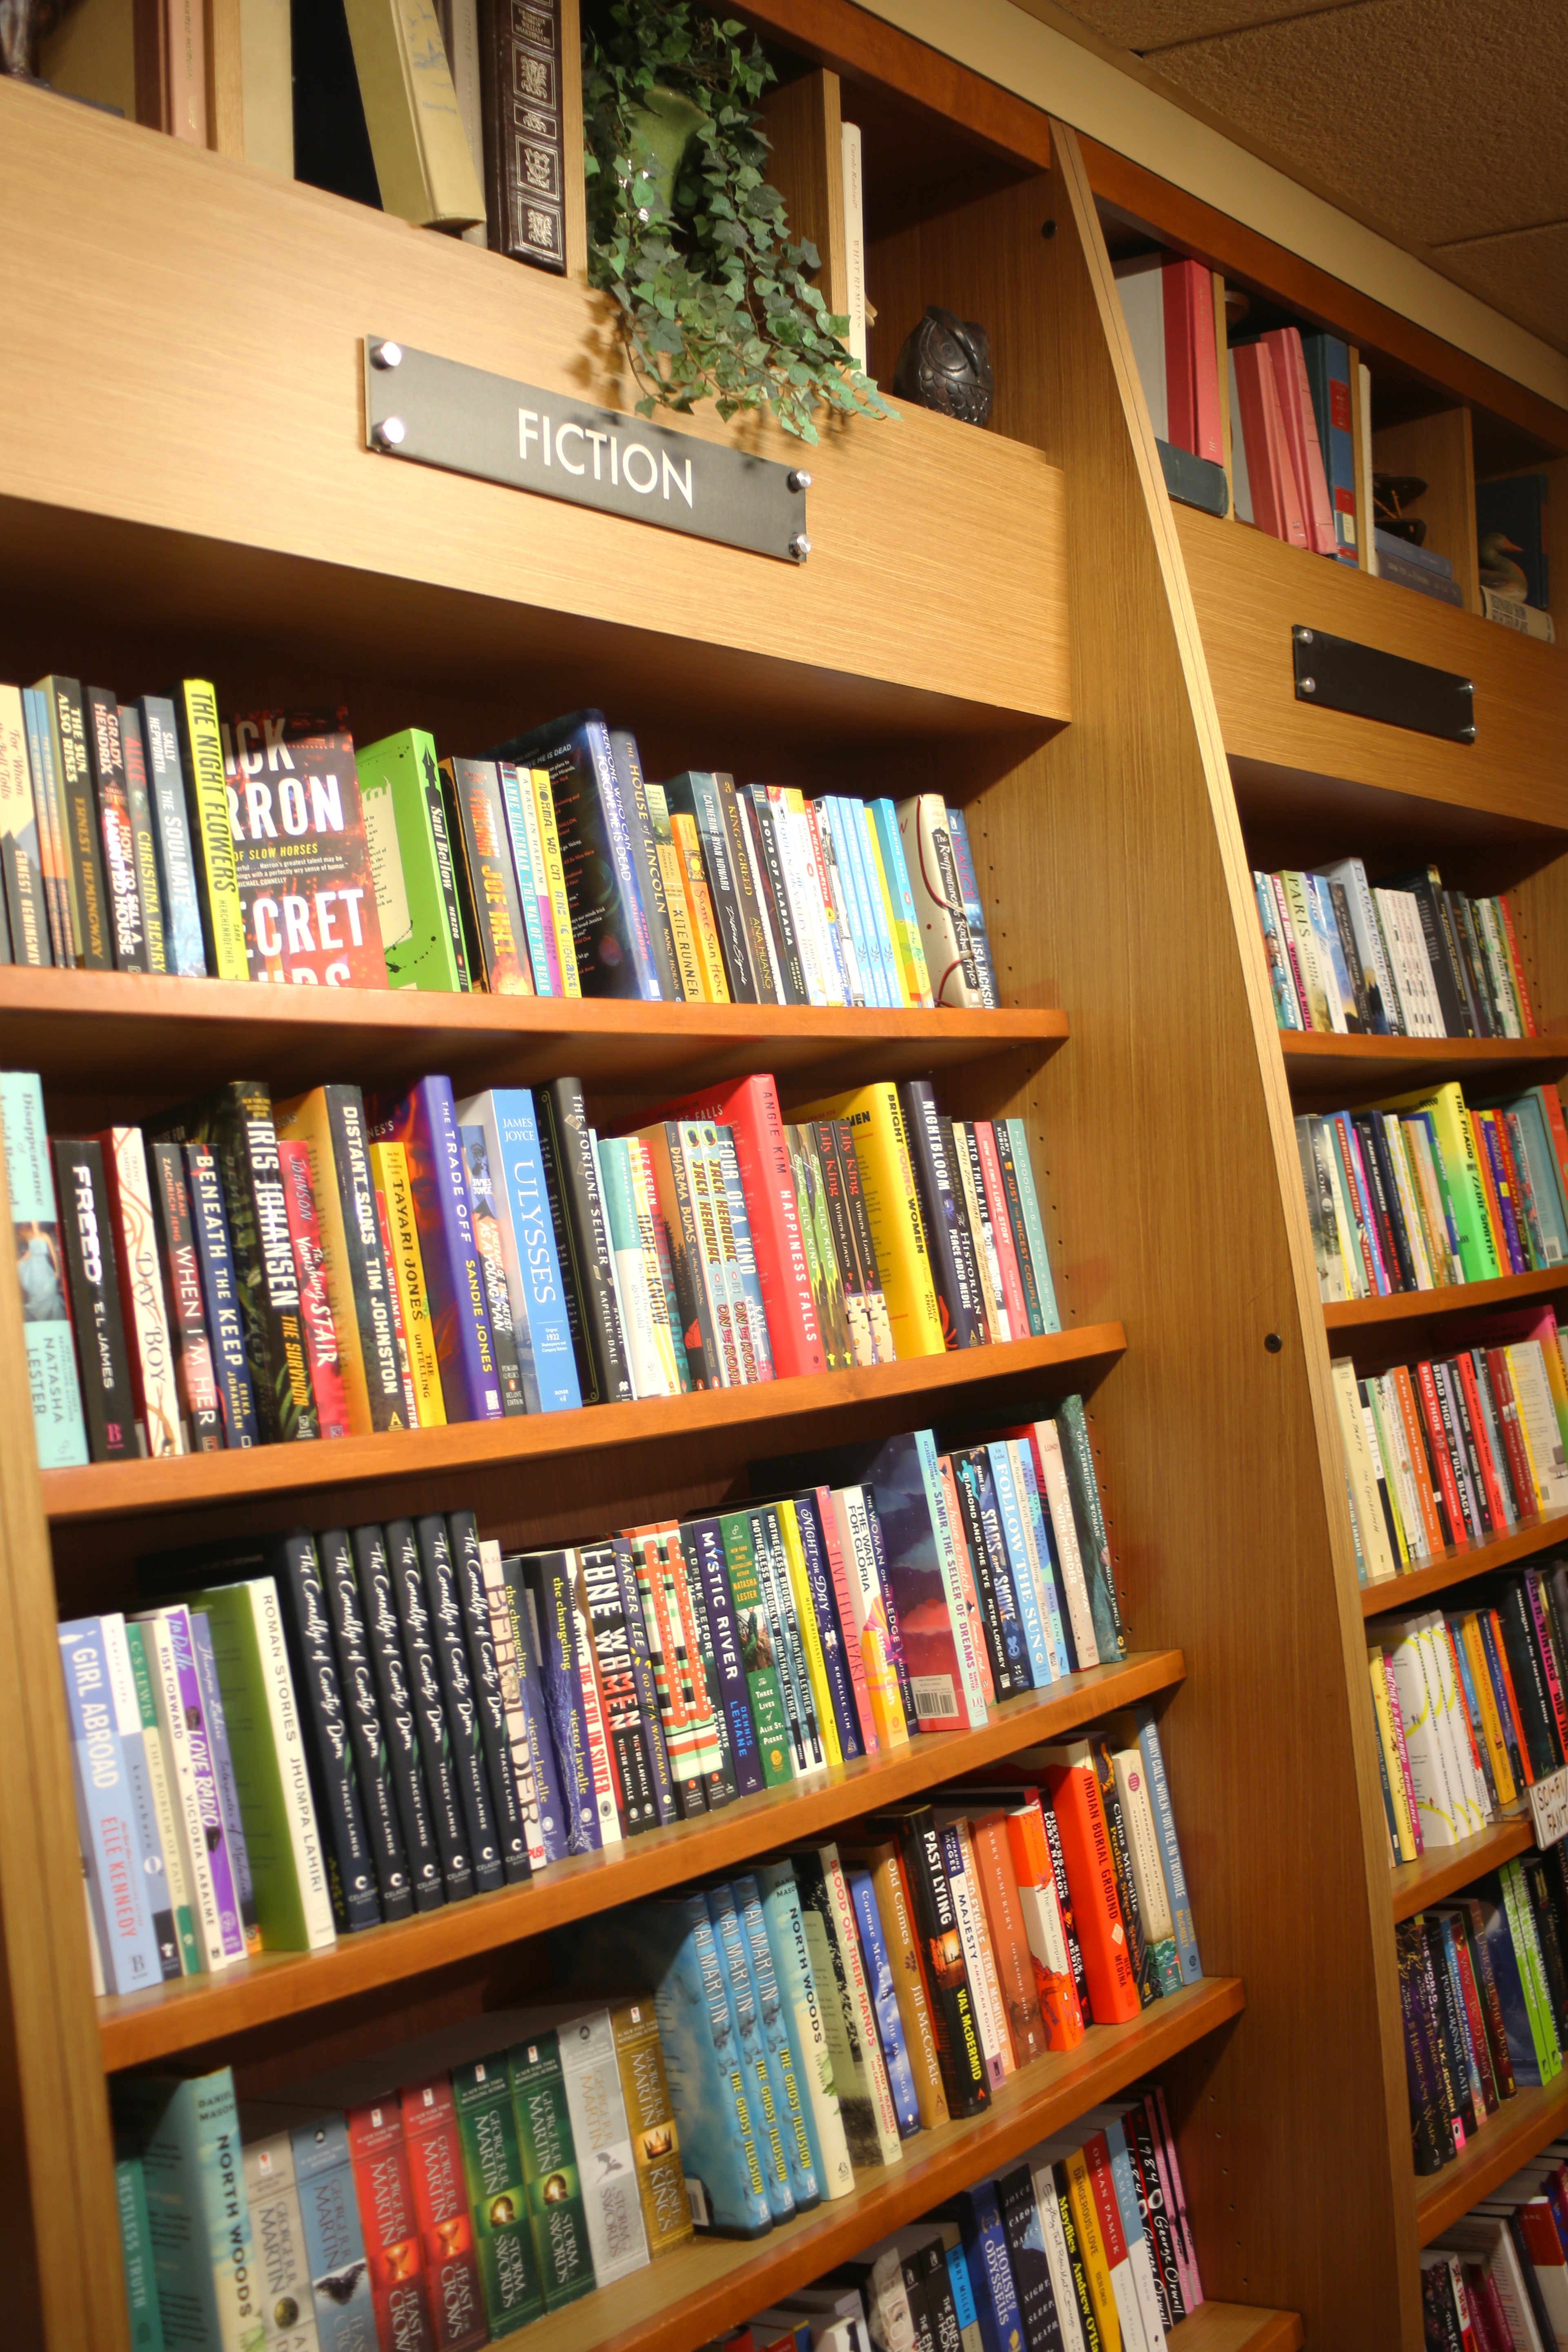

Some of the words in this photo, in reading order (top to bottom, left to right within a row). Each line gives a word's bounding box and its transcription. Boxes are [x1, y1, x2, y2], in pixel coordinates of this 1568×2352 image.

[515, 24, 550, 45] SHAKESPEARE
[521, 20, 543, 36] WILLIAM
[519, 408, 692, 508] FICTION
[58, 692, 72, 731] ALSO
[70, 707, 82, 736] THE
[191, 693, 215, 728] THE
[61, 738, 78, 783] RISES
[75, 744, 88, 773] SUN
[149, 717, 165, 773] HEPWORTH
[163, 732, 176, 761] SALLY
[197, 735, 224, 795] NIGHT
[626, 742, 635, 759] THE
[161, 789, 173, 810] THE
[505, 780, 519, 809] ANNE
[597, 755, 617, 810] FORGIVE
[630, 765, 648, 821] HOUSE
[74, 797, 90, 854] ERNEST
[432, 806, 447, 842] Saul
[608, 811, 620, 830] ME
[613, 831, 623, 842] IS
[703, 795, 719, 837] CATHERINE
[165, 816, 192, 908] SOULMATE
[206, 803, 236, 893] FLOWERS
[249, 847, 276, 860] SLOW
[280, 844, 318, 856] HORSES
[510, 811, 530, 873] HILLERMAN
[616, 846, 631, 882] DEAD
[712, 838, 724, 859] RYAN
[728, 805, 740, 837] KING
[738, 853, 752, 896] GREED
[137, 831, 159, 913] CHRISTINA
[439, 845, 451, 891] Bellow
[482, 864, 507, 905] JOE
[521, 881, 531, 902] THE
[644, 838, 667, 913] LINCOLN
[716, 863, 730, 891] HOWARD
[762, 820, 774, 854] BOYS
[771, 860, 777, 876] OF
[775, 882, 793, 945] ALABAMA
[80, 862, 102, 958] HEMINGWAY
[449, 906, 459, 939] HERZOG
[489, 911, 515, 956] HILL
[524, 905, 537, 925] WAY
[530, 926, 537, 939] OF
[147, 921, 166, 972] HENRY
[532, 942, 541, 963] THE
[673, 909, 684, 937] KITE
[679, 938, 698, 996] RUNNER
[536, 964, 551, 991] BEAR
[442, 1101, 451, 1123] THE
[503, 1118, 533, 1129] JAMES
[572, 1094, 586, 1122] THE
[763, 1091, 779, 1137] ANGIE
[773, 1147, 786, 1174] KIM
[888, 1094, 903, 1143] BRIGHT
[1454, 1093, 1465, 1116] THE
[1461, 1120, 1473, 1159] FRAUD
[246, 1121, 279, 1169] IRIS
[343, 1107, 368, 1190] DISTANT
[505, 1129, 535, 1142] JOYCE
[718, 1140, 735, 1180] FOUR
[922, 1100, 950, 1190] NIGHTBLOOM
[445, 1130, 464, 1196] TRADE
[578, 1131, 598, 1201] FORTUNE
[895, 1147, 913, 1196] YOUNG
[967, 1134, 979, 1160] INTO
[973, 1166, 983, 1193] THIN
[978, 1197, 988, 1220] AIR
[196, 1156, 227, 1258] BENEATH
[353, 1192, 376, 1245] SONS
[457, 1204, 472, 1242] OFF
[727, 1191, 738, 1208] OF
[729, 1215, 741, 1226] A
[73, 1166, 102, 1284] FREED
[254, 1180, 299, 1307] JOHANSEN
[514, 1160, 556, 1303] ULYSSES
[590, 1209, 608, 1265] SELLER
[909, 1197, 924, 1254] WOMEN
[1481, 1214, 1493, 1254] SMITH
[312, 1247, 324, 1264] The
[366, 1258, 383, 1290] TIM
[393, 1179, 413, 1251] TAYARI
[404, 1259, 423, 1321] JONES
[736, 1237, 755, 1274] KIND
[780, 1190, 806, 1283] HAPPINESS
[799, 1292, 817, 1342] FALLS
[176, 1246, 200, 1317] WHEN
[215, 1268, 231, 1298] THE
[295, 1237, 325, 1299] Vanishing
[310, 1304, 337, 1366] STAR
[218, 1309, 243, 1366] KEEP
[281, 1316, 300, 1339] THE
[466, 1260, 483, 1316] SANDIE
[476, 1323, 492, 1372] JONES
[187, 1329, 207, 1365] I'M
[371, 1298, 398, 1394] JOHNSTON
[286, 1344, 308, 1406] SURVIVOR
[1421, 1365, 1433, 1398] BRAD
[1429, 1400, 1441, 1431] THOR
[193, 1377, 216, 1425] HER
[857, 1503, 868, 1532] THE
[980, 1508, 1001, 1553] STARS
[300, 1546, 315, 1574] The
[848, 1505, 860, 1535] FOR
[855, 1537, 870, 1592] GLORIA
[862, 1534, 874, 1566] WAR
[991, 1554, 1004, 1573] and
[996, 1463, 1023, 1553] FOLLOW
[1017, 1559, 1033, 1603] THE
[1025, 1606, 1042, 1649] SUN
[303, 1579, 329, 1644] Connellys
[701, 1531, 726, 1608] MYSTIC
[715, 1615, 737, 1680] RIVER
[993, 1575, 1016, 1623] SMOKE
[73, 1647, 102, 1697] GIRL
[312, 1650, 330, 1661] of
[319, 1667, 339, 1715] County
[82, 1704, 119, 1788] ABROAD
[327, 1719, 345, 1759] Down
[730, 1700, 747, 1757] LEHANE
[738, 1706, 753, 1747] DENNIS
[528, 1717, 540, 1757] victor
[535, 1761, 549, 1803] lavalle
[500, 1748, 510, 1785] TRACEY
[506, 1789, 516, 1822] LANGE
[1084, 1777, 1100, 1819] INDIAN
[1092, 1822, 1109, 1865] BURIAL
[1101, 1866, 1118, 1919] GROUND
[923, 1831, 942, 1871] PAST
[933, 1873, 952, 1925] LYING
[694, 1915, 713, 1955] KAI
[958, 1894, 977, 1960] MAJESTY
[699, 1960, 729, 2024] MARTIN
[789, 1907, 808, 1970] NORTH
[804, 1975, 822, 2044] WOODS
[957, 1988, 969, 2014] VAL
[961, 2013, 982, 2080] McDERMID
[730, 2071, 741, 2093] THE
[736, 2097, 752, 2136] GHOST
[744, 2139, 763, 2195] ILLUSION
[1092, 2147, 1108, 2198] ORHAN
[1105, 2203, 1120, 2255] PAMUK
[1138, 2138, 1158, 2183] 1984
[1154, 2216, 1171, 2264] George
[1163, 2267, 1185, 2316] Orwell
